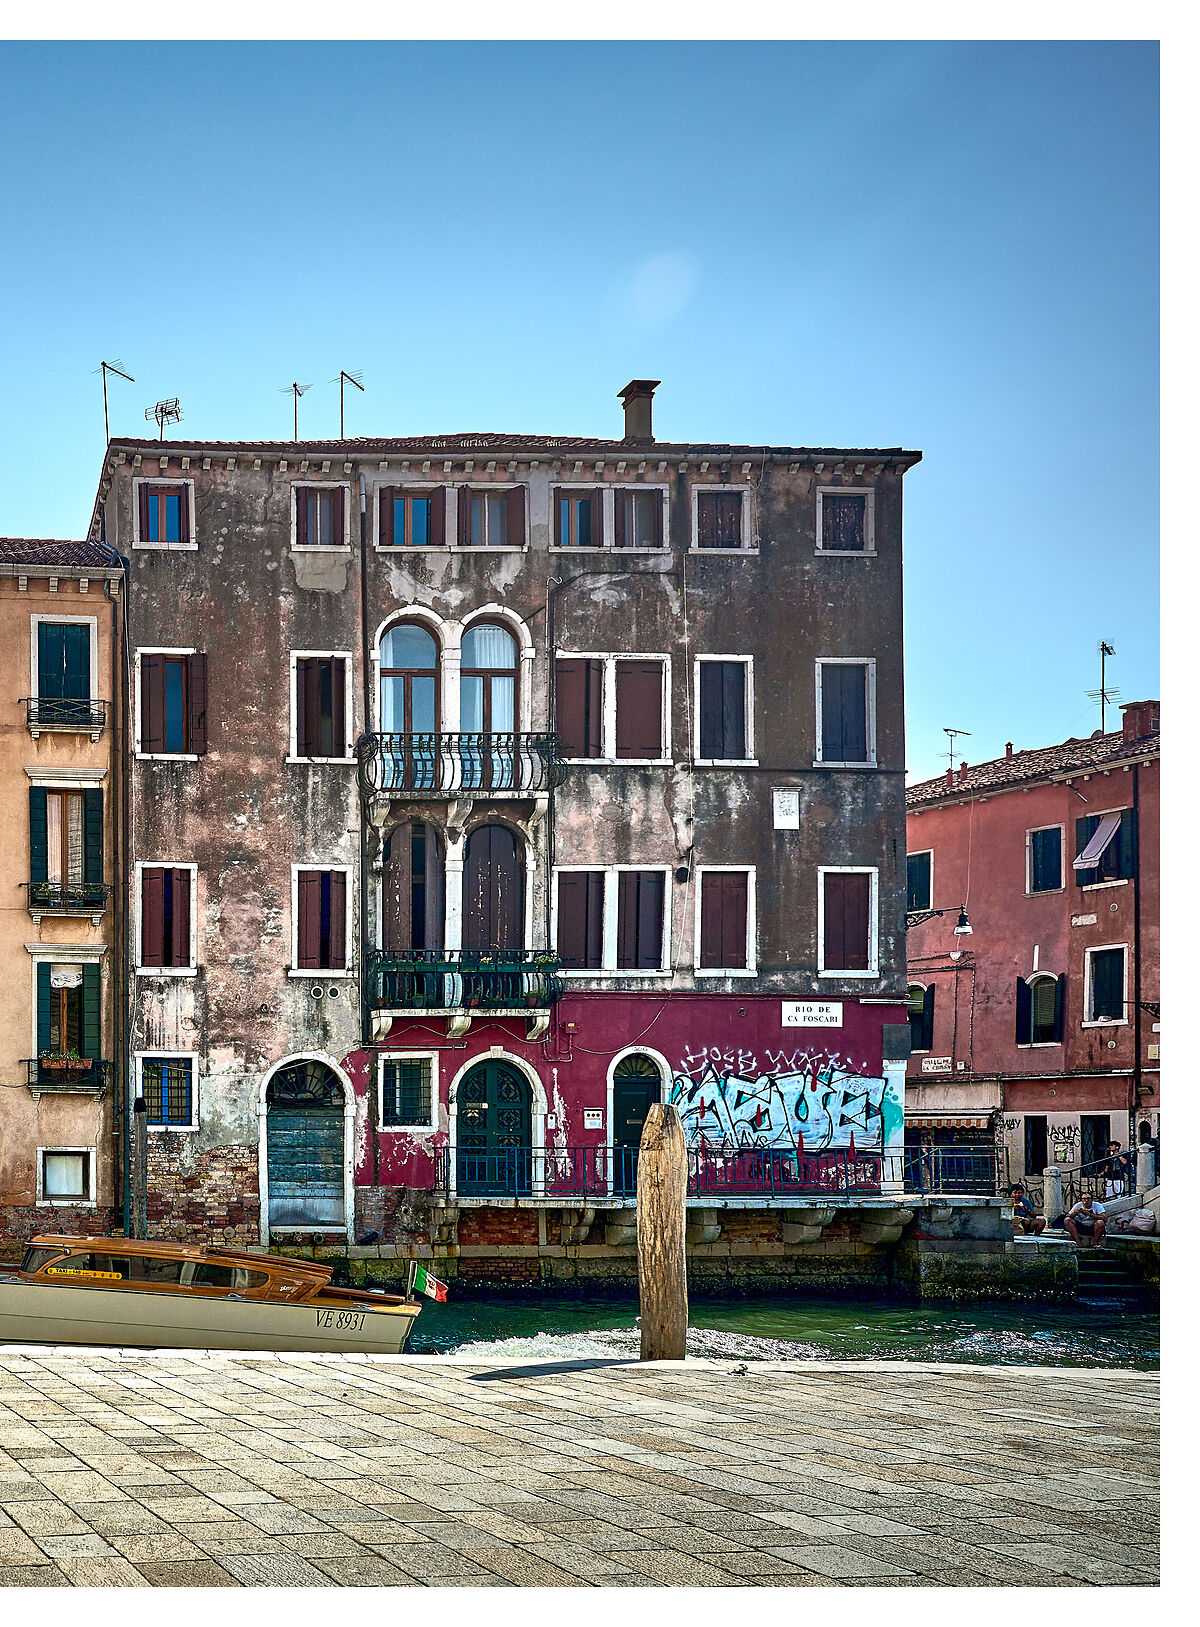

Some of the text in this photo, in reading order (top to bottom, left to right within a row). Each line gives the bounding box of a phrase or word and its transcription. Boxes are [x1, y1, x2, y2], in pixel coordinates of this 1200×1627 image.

[803, 1015, 838, 1023] FOSCARI
[315, 1309, 366, 1331] VE 8931
